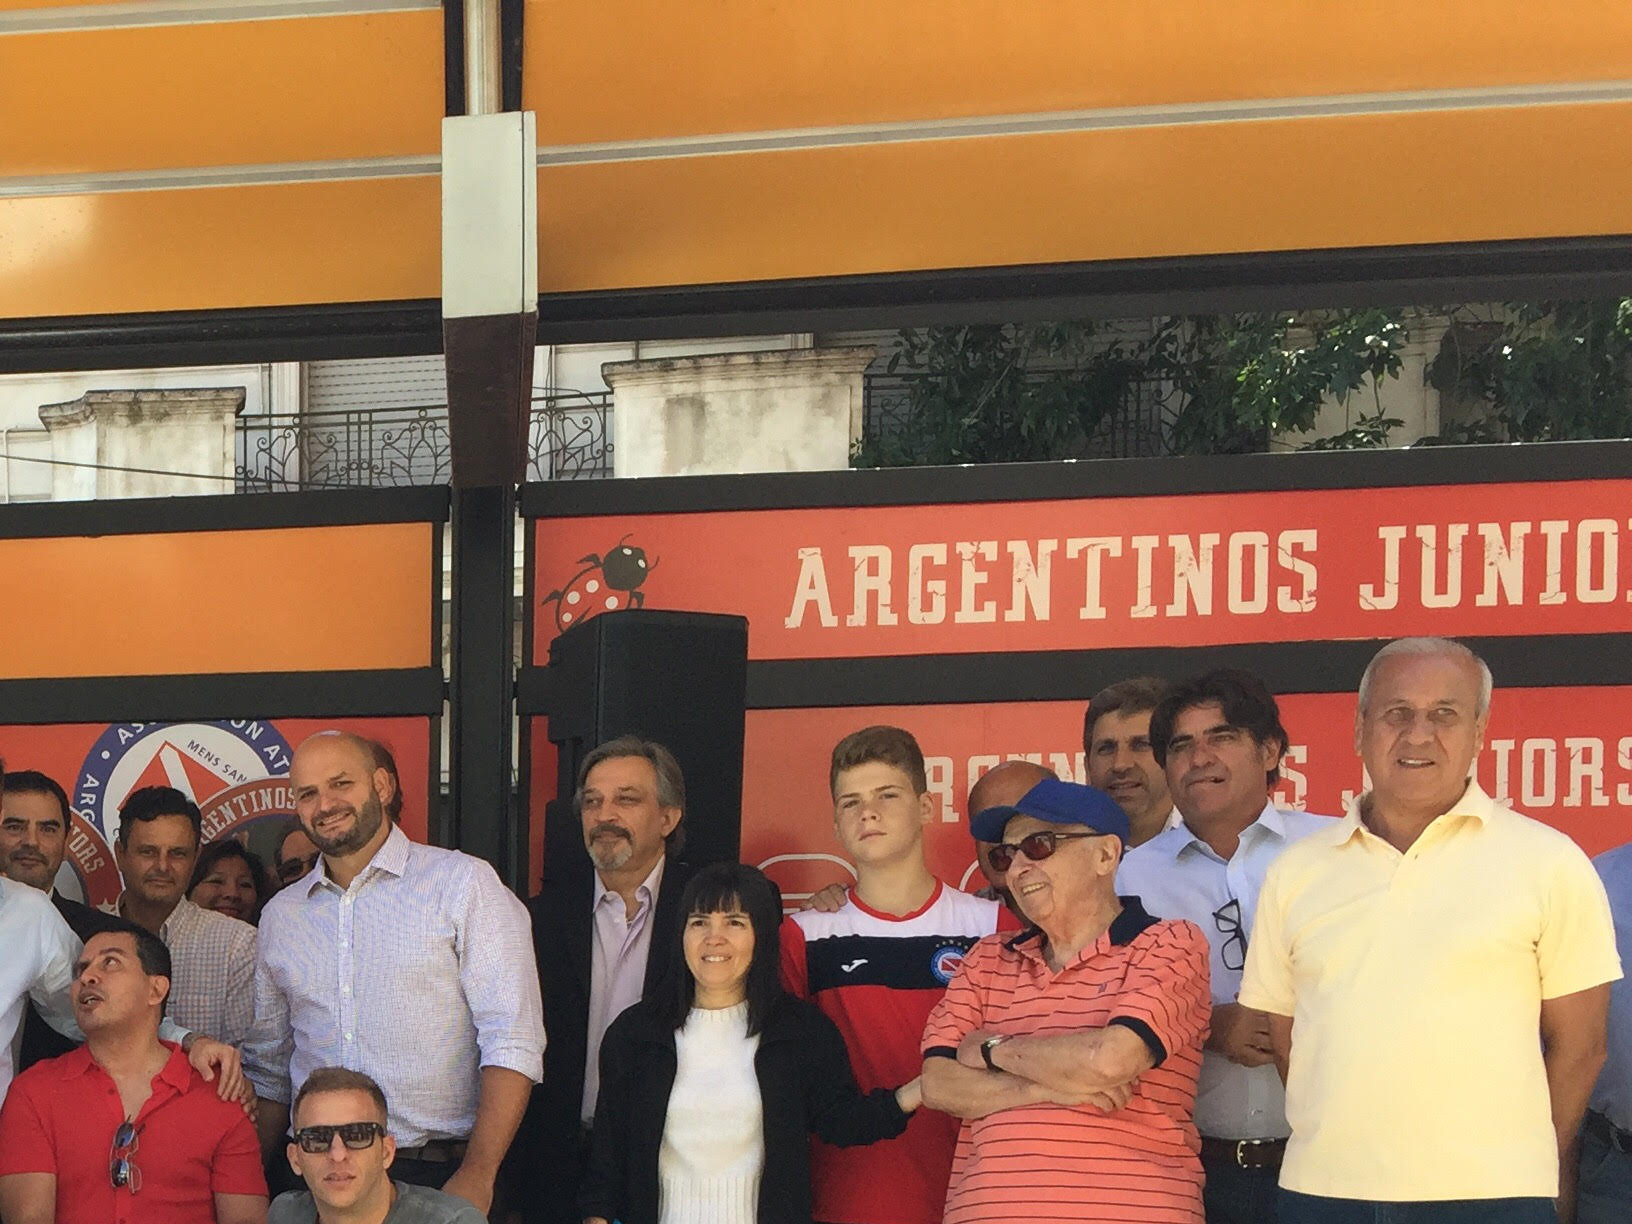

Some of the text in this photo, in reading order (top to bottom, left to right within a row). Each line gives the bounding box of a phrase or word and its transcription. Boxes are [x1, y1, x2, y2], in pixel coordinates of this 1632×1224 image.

[784, 518, 1632, 629] ARGENTINOS JUNIO
[187, 739, 248, 783] MENS SAN
